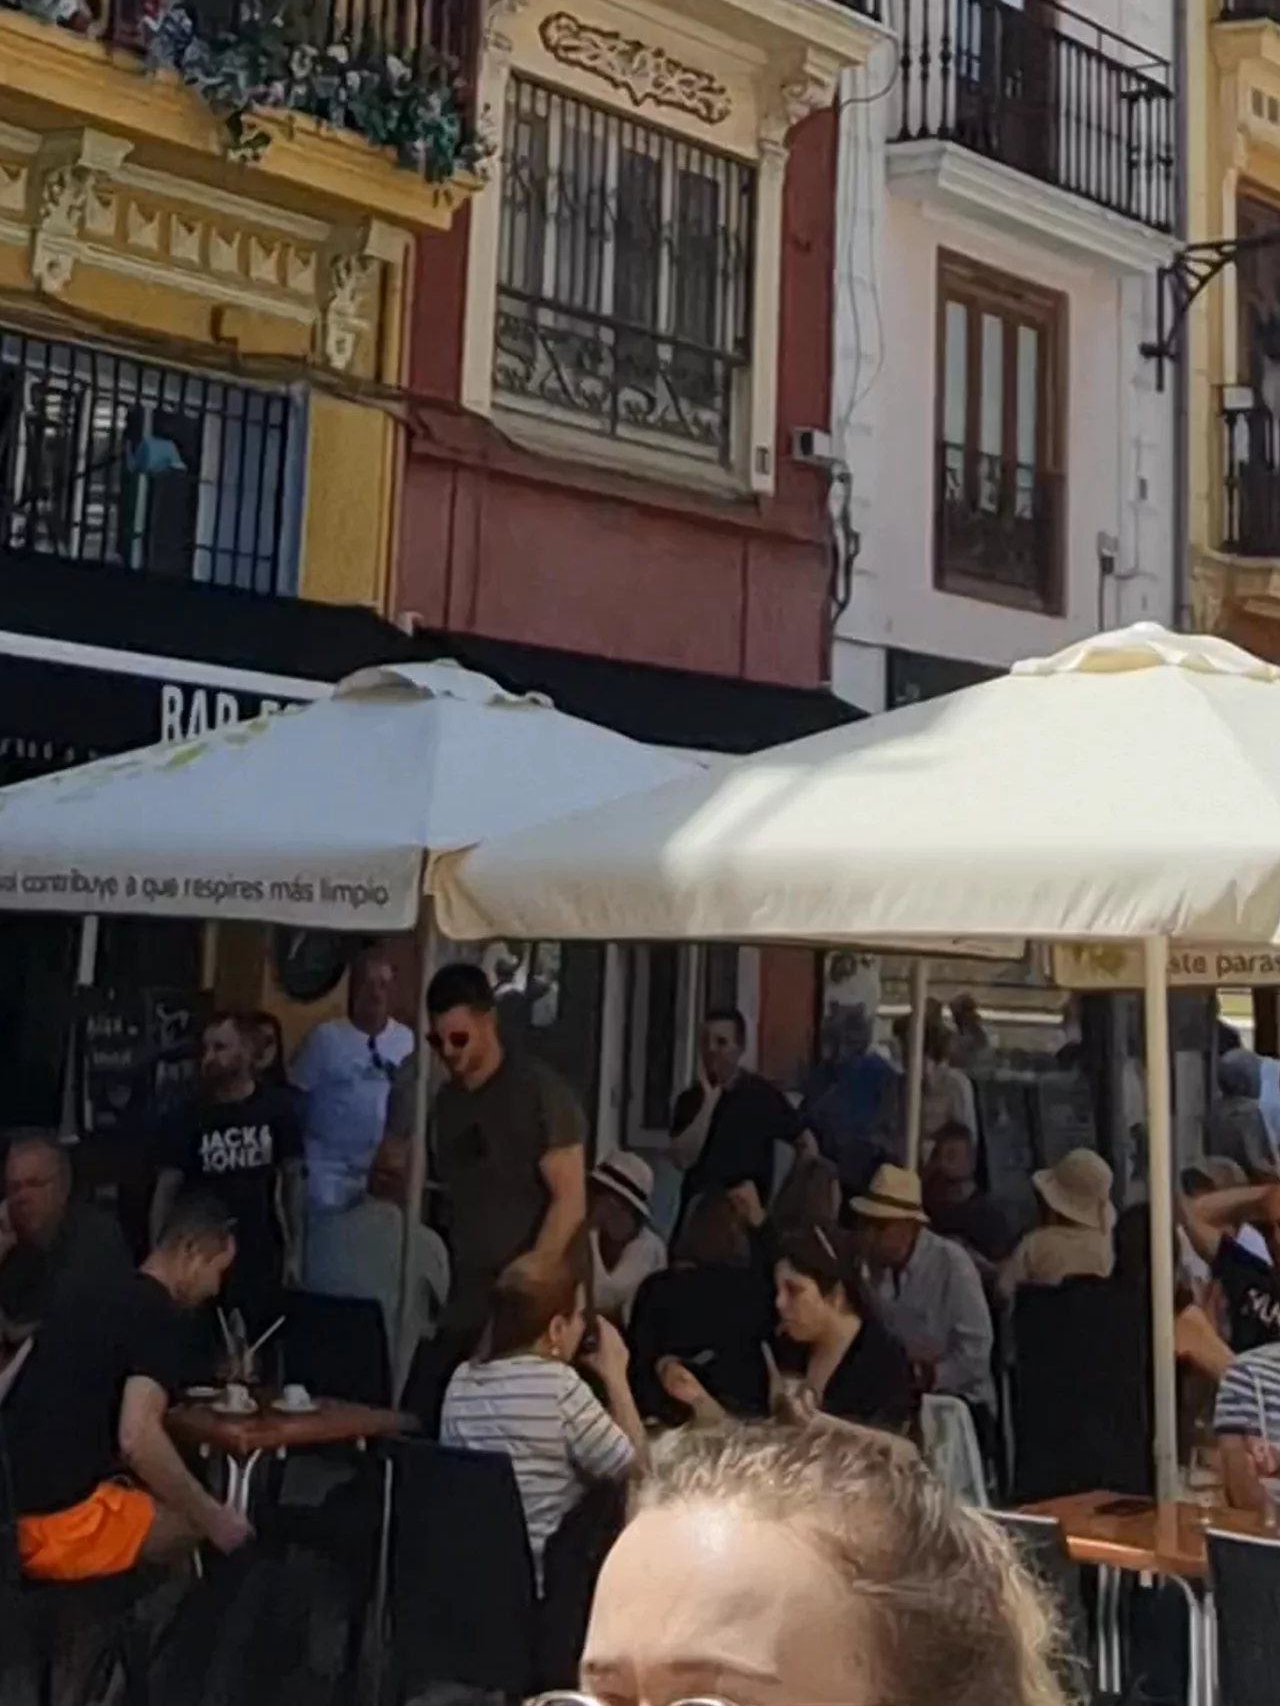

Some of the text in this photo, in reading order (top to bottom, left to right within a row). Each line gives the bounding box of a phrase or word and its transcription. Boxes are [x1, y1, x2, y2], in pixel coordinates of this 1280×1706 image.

[21, 867, 119, 902] contribuye
[143, 875, 179, 903] que
[184, 872, 265, 905] respires
